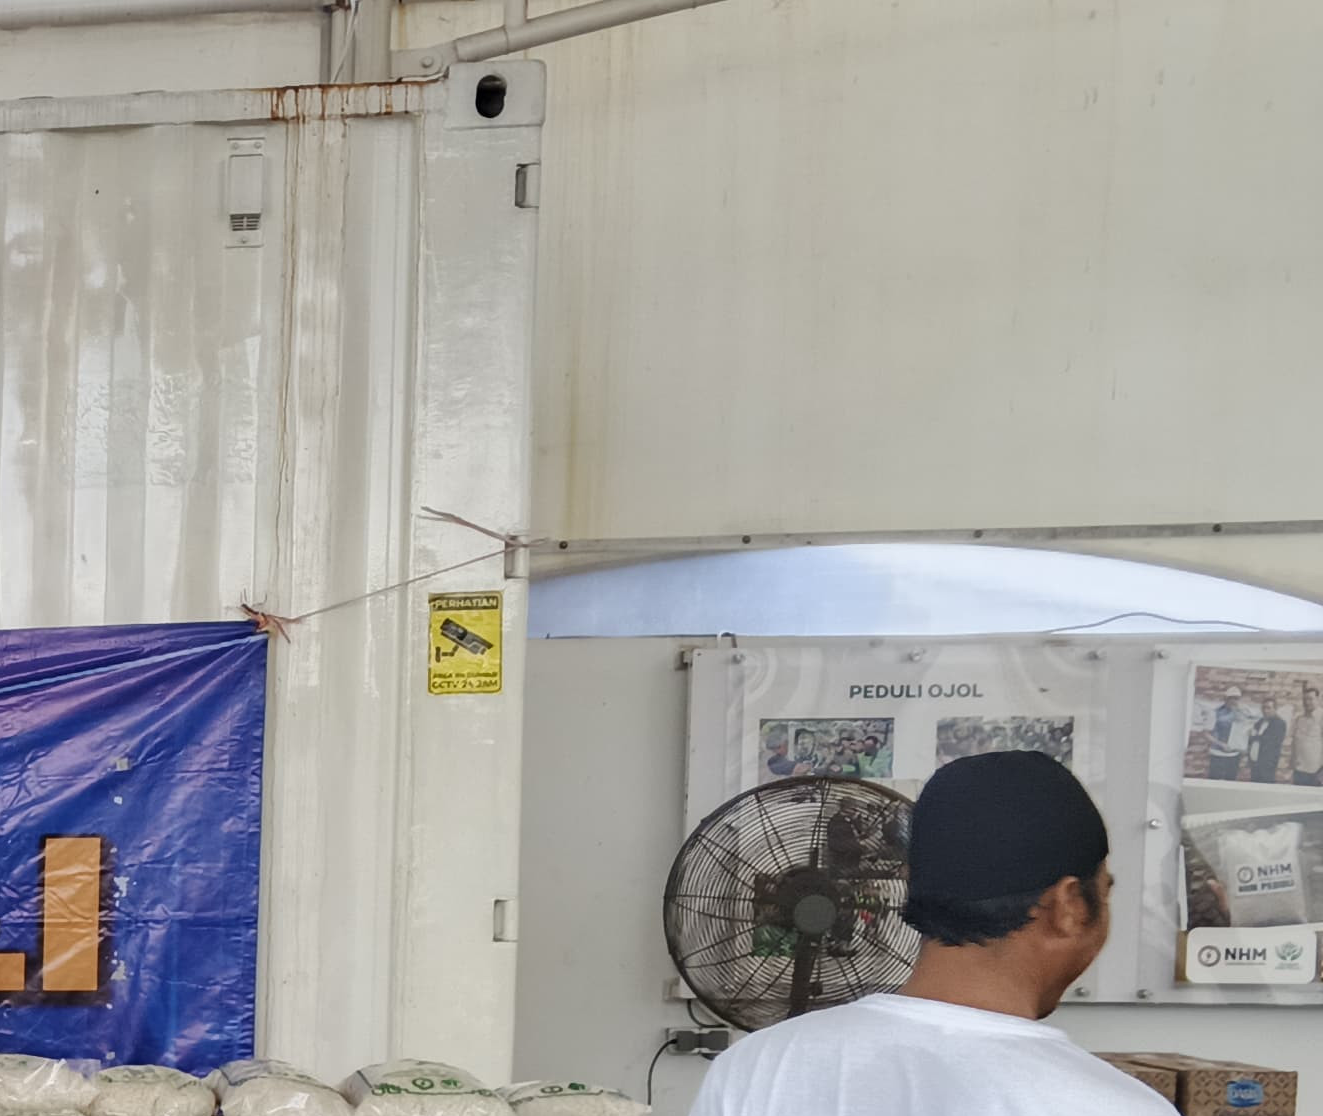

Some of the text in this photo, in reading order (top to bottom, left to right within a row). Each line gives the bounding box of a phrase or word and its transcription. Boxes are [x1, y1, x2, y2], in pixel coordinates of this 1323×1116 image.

[434, 597, 497, 609] PERHATIAN
[850, 684, 983, 698] PEDULI OJOL
[1258, 863, 1292, 877] NHM
[1224, 948, 1267, 961] NHM
